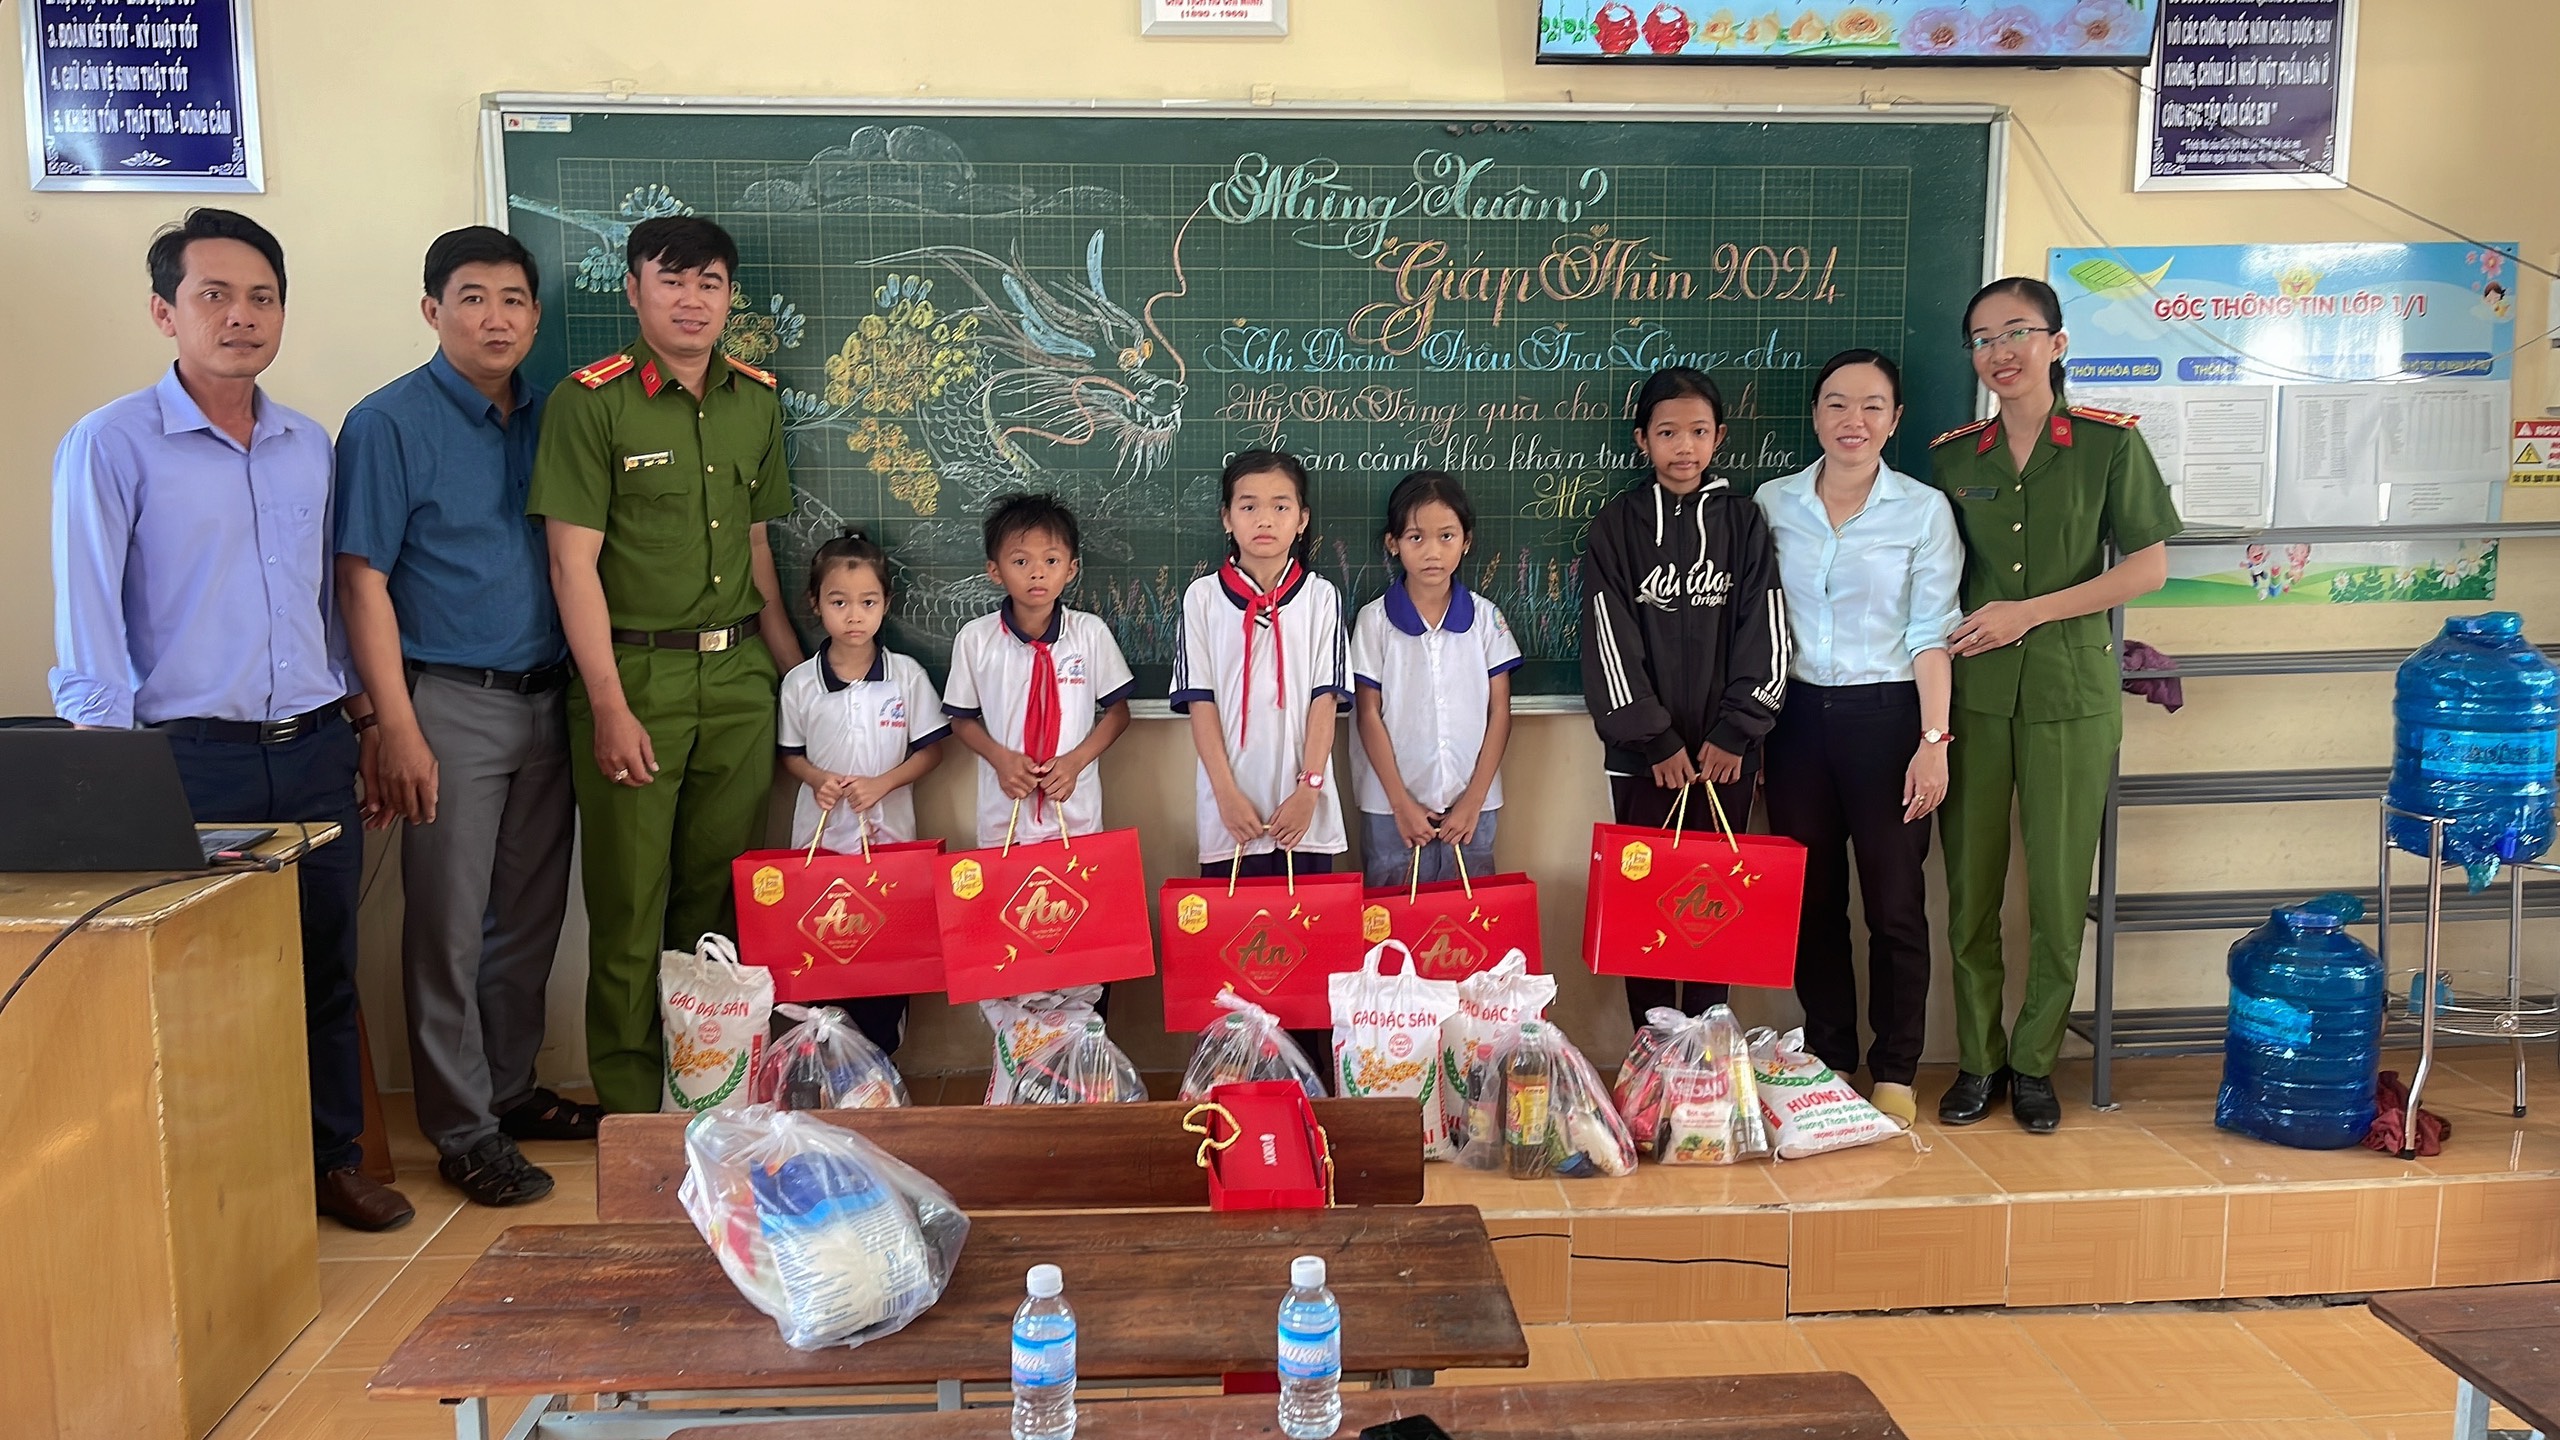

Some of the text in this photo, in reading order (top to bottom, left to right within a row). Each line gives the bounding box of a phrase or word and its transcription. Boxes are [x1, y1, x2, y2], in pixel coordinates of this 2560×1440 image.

[109, 13, 129, 48] TỐT
[178, 13, 198, 48] TỐT
[168, 56, 188, 91] TỐT
[1704, 243, 1846, 305] 2024
[2154, 290, 2427, 320] GÓC THÔNG TIN LỚP 1/1
[2097, 363, 2130, 377] KHÓA
[1553, 380, 1612, 422] cho
[1757, 430, 1797, 475] học
[814, 898, 872, 940] An
[1016, 886, 1076, 931] An
[1674, 883, 1728, 919] An
[1239, 929, 1292, 969] An
[1420, 933, 1474, 971] An
[1786, 1090, 1842, 1113] HƯƠNG
